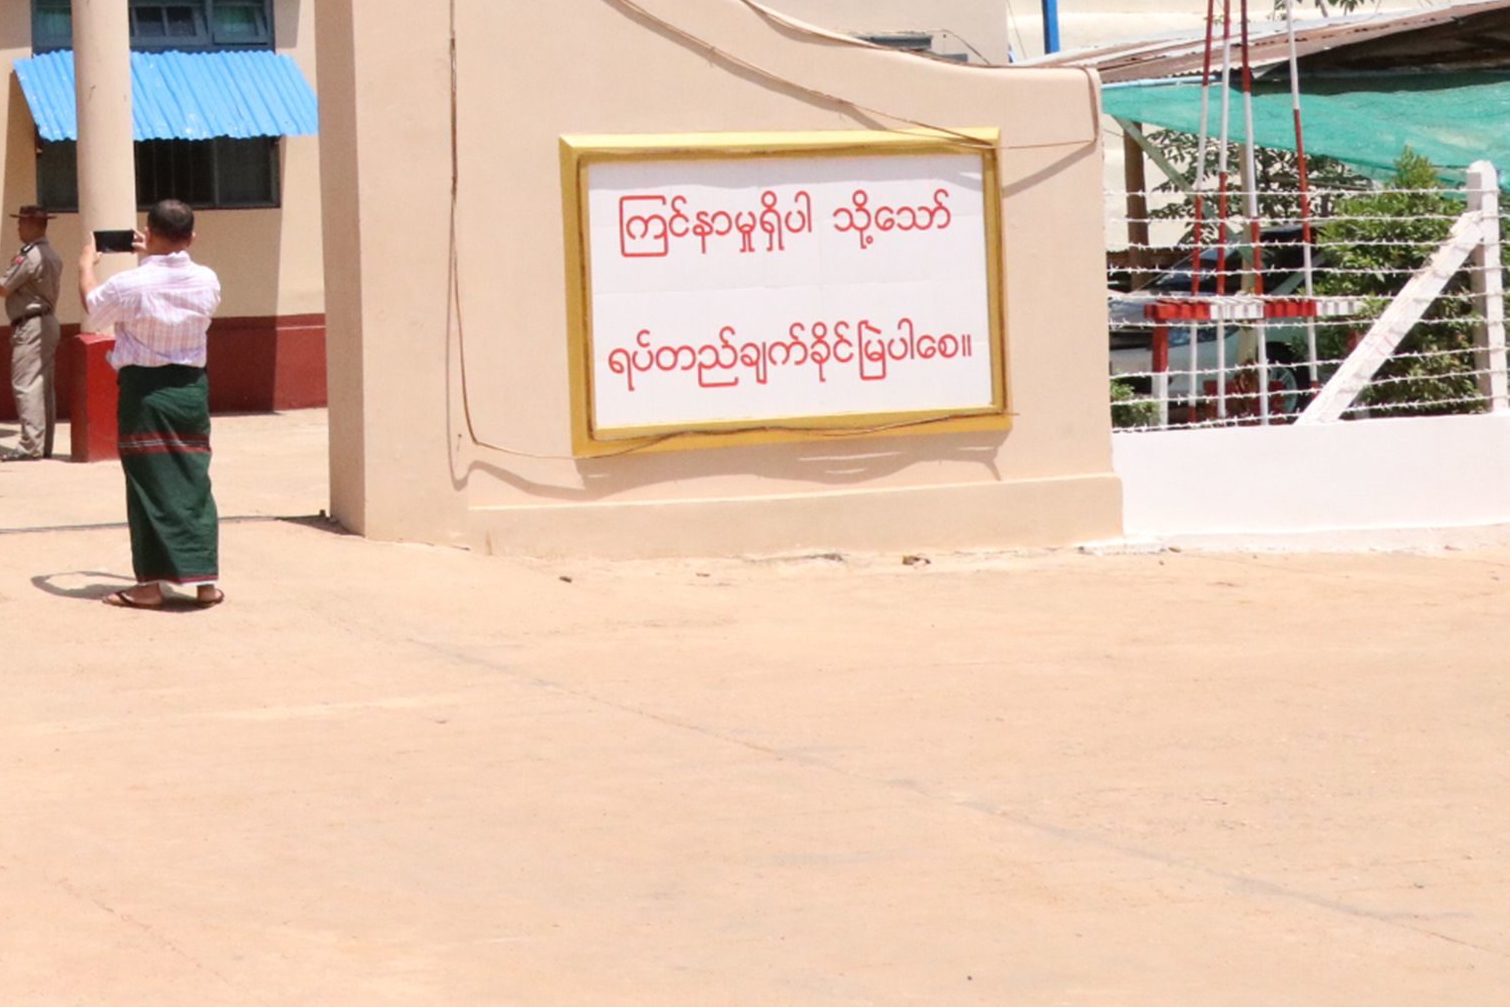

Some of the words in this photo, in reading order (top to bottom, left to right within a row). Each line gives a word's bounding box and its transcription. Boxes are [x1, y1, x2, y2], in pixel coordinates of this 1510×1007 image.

[618, 190, 813, 258] ကြင်နာမှုရှိပါ
[832, 188, 952, 250] သို့သော်
[607, 317, 973, 392] ရပ်တည်ချက်ခိုင်မြဲပါစေ။
